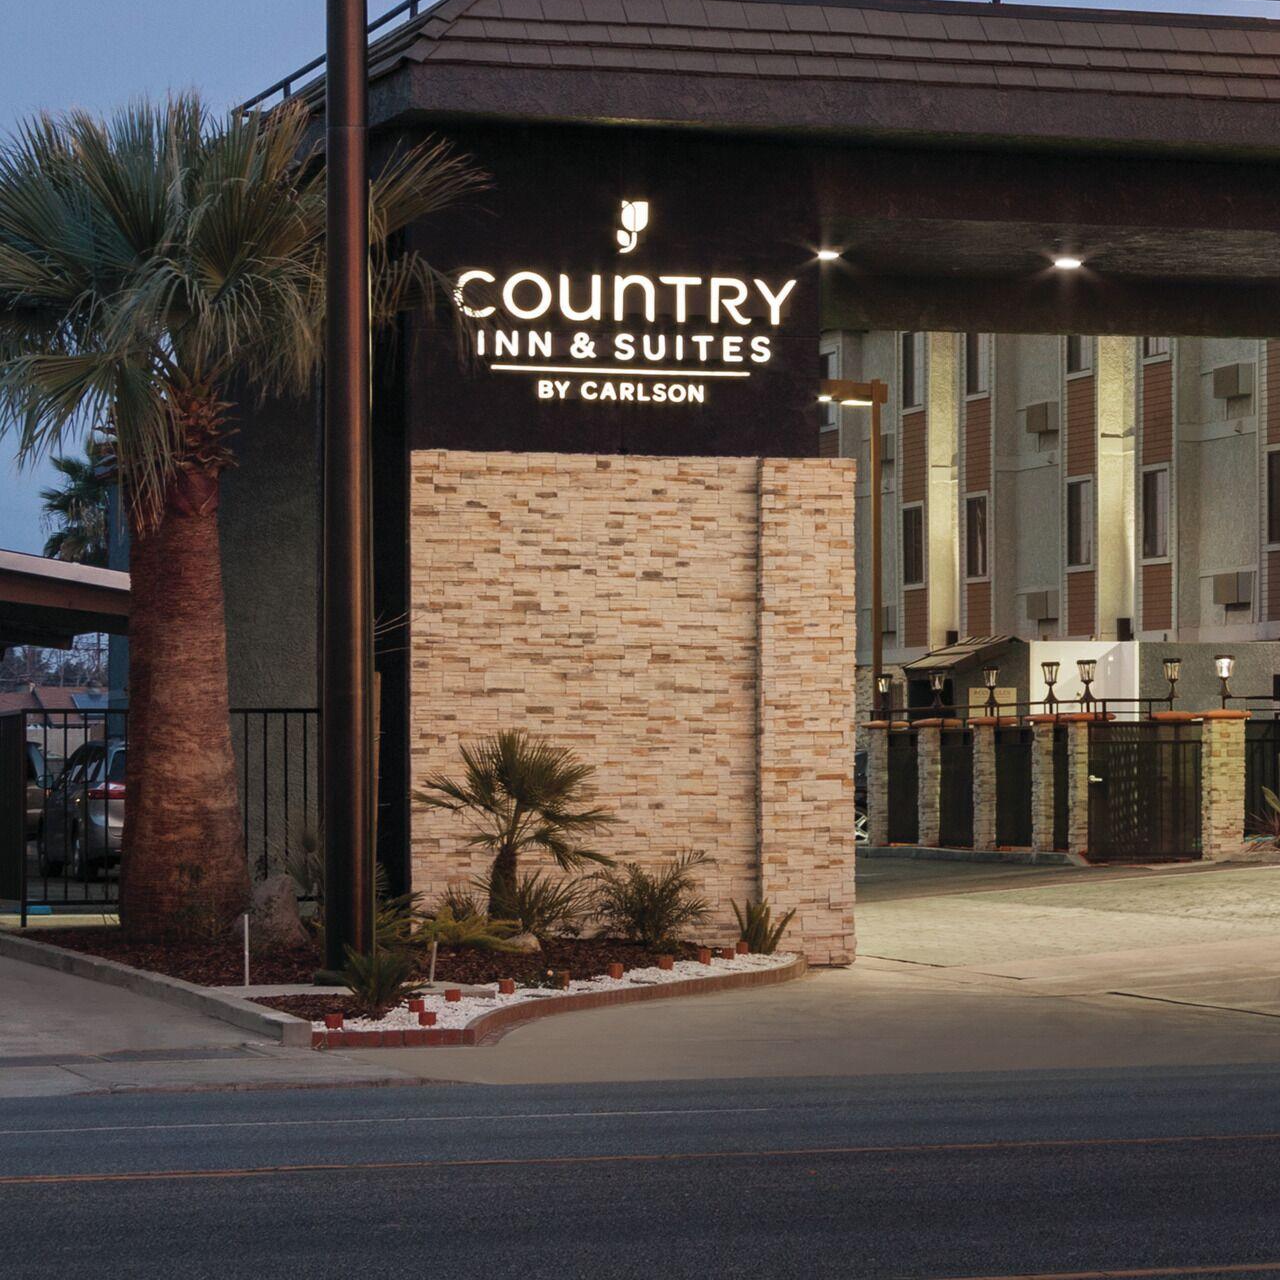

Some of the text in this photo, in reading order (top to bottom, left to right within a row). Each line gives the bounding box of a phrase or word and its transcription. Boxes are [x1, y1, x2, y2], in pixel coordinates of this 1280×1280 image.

[476, 329, 772, 364] INN & SUITES
[537, 379, 705, 404] BY CARLSON
